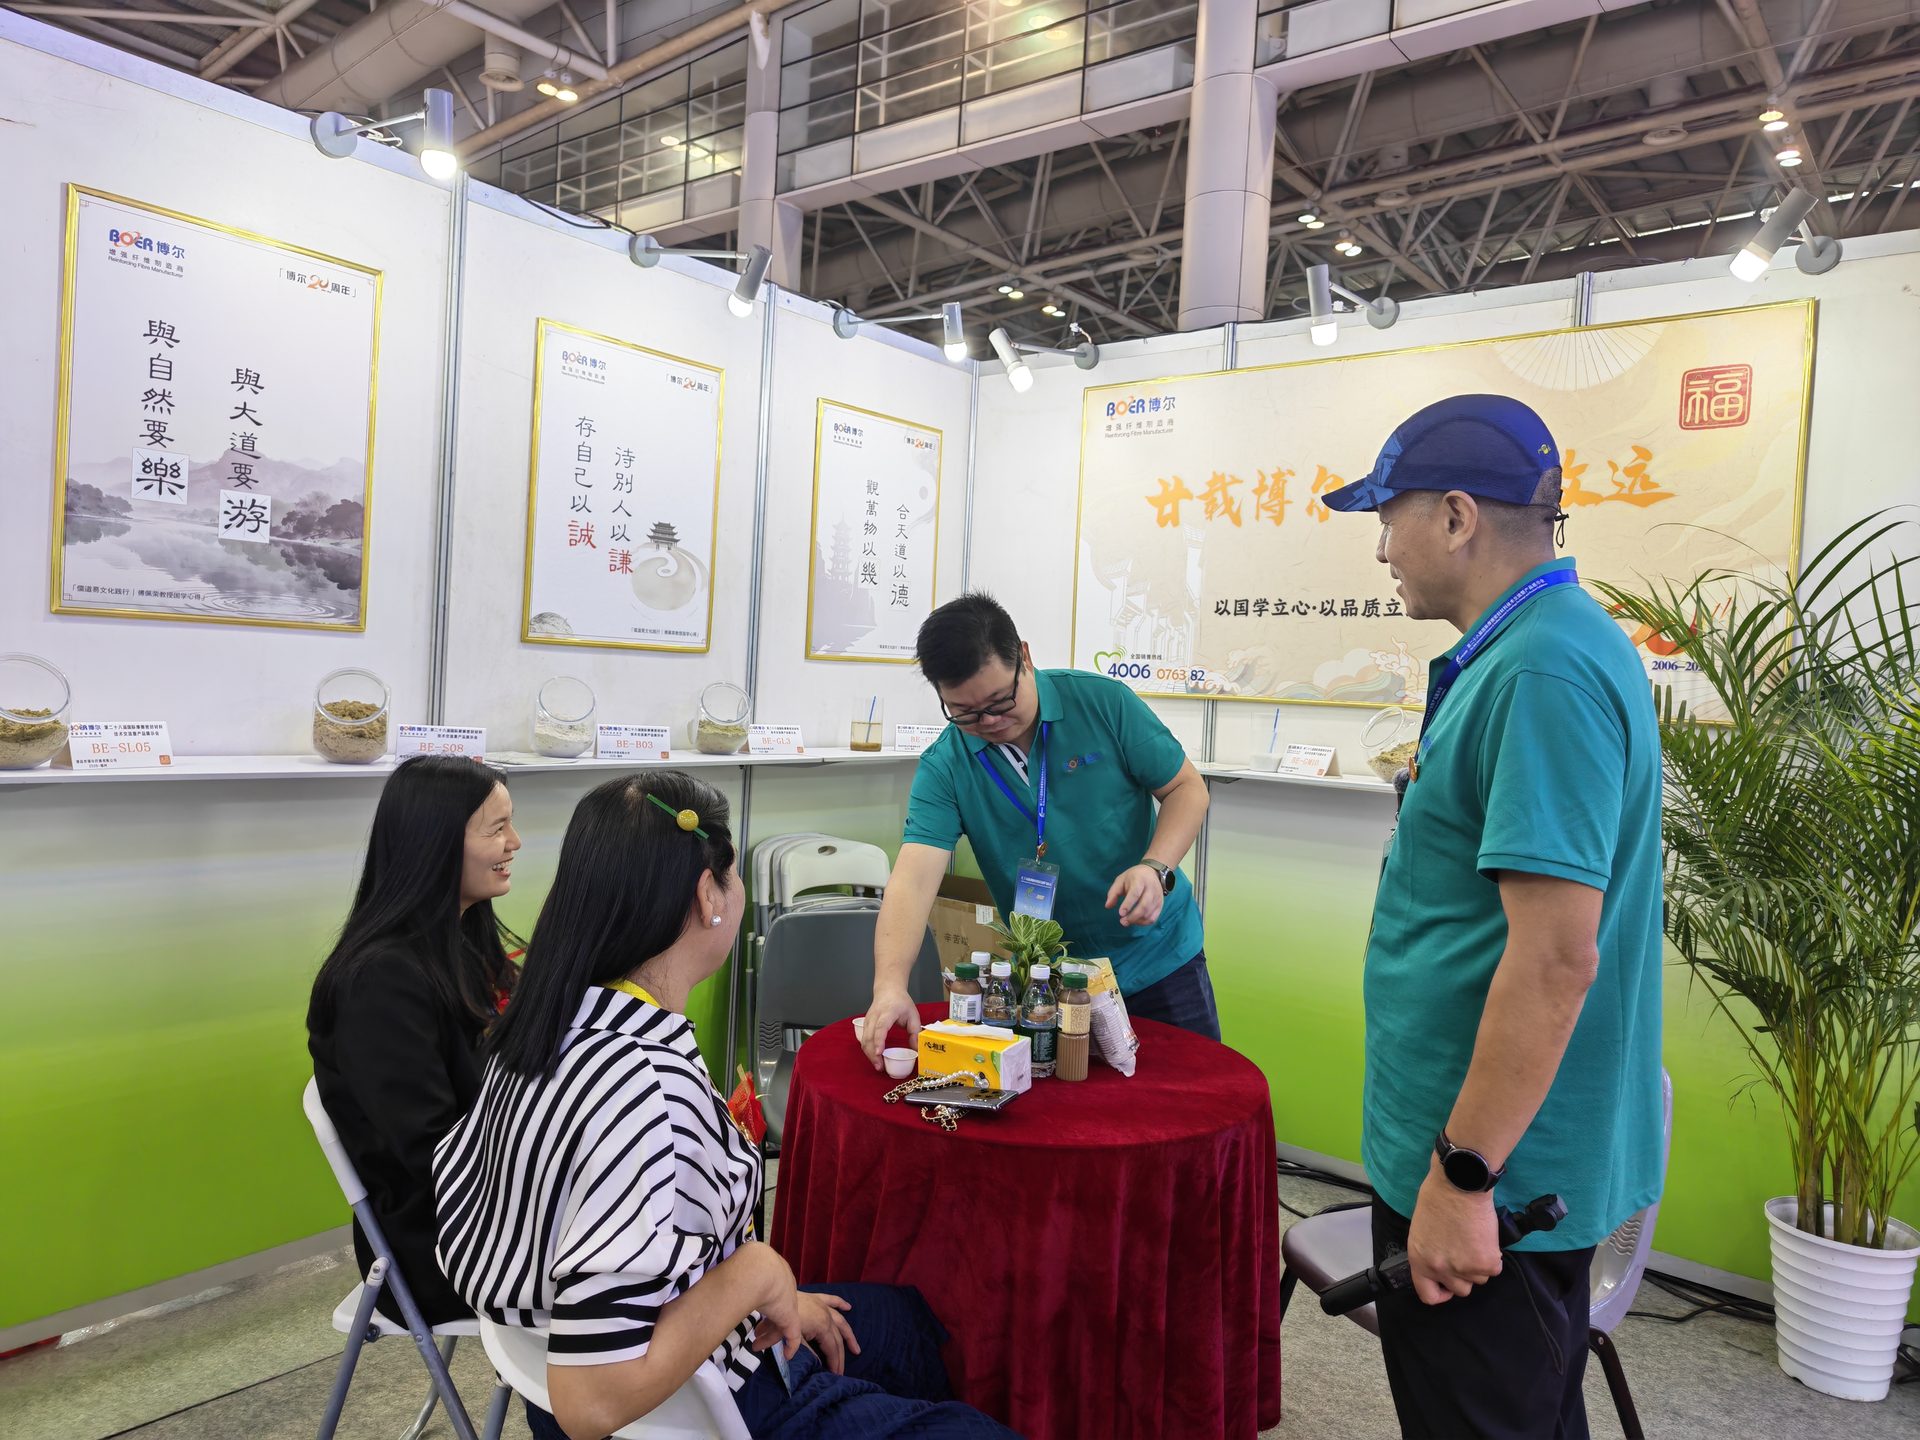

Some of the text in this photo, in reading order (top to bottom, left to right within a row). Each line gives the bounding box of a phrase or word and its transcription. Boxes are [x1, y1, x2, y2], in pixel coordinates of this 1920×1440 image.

[109, 229, 185, 259] BOER 博尔
[108, 255, 183, 278] Reinforcing Fibre Manufacturer
[562, 350, 588, 366] BOER
[1106, 395, 1176, 418] BOER 博尔
[1684, 370, 1746, 426] 福
[1214, 598, 1408, 618] 以国学立心·以品质立
[1108, 663, 1205, 681] 4006 0763 82
[1652, 660, 1704, 672] 2006–20
[91, 742, 152, 754] BE-SL05
[419, 742, 464, 753] BE-S08
[616, 739, 653, 749] BE-B03
